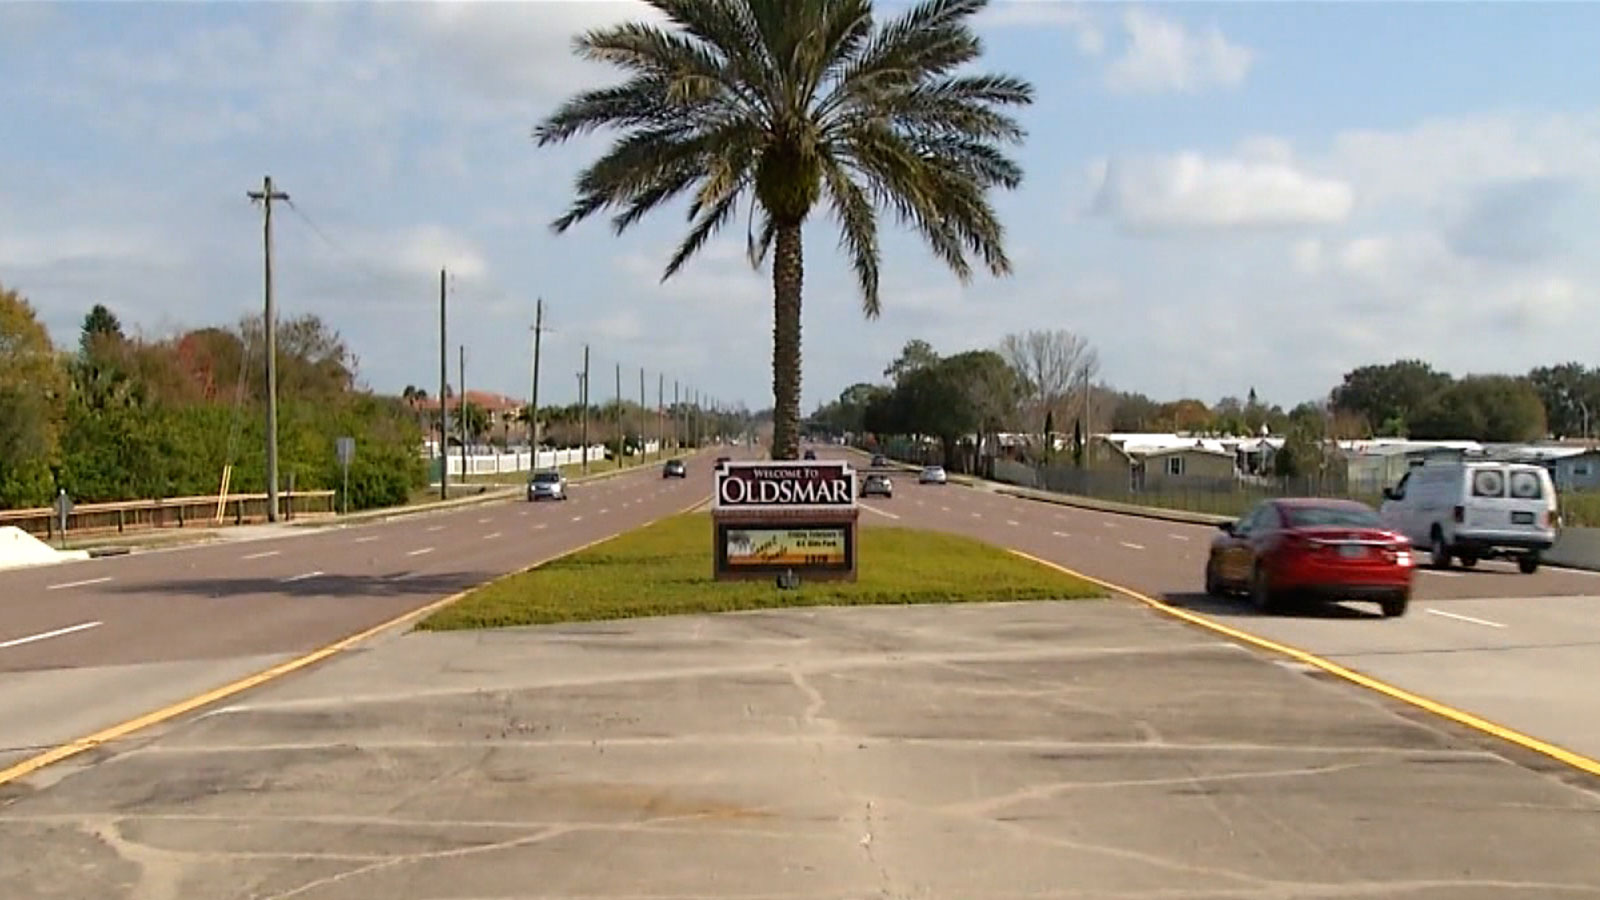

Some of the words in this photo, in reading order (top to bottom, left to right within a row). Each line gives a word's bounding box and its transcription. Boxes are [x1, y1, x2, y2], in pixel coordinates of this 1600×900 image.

[753, 468, 802, 479] WELCOME
[803, 468, 819, 479] TO
[721, 477, 850, 503] OLDSMAR
